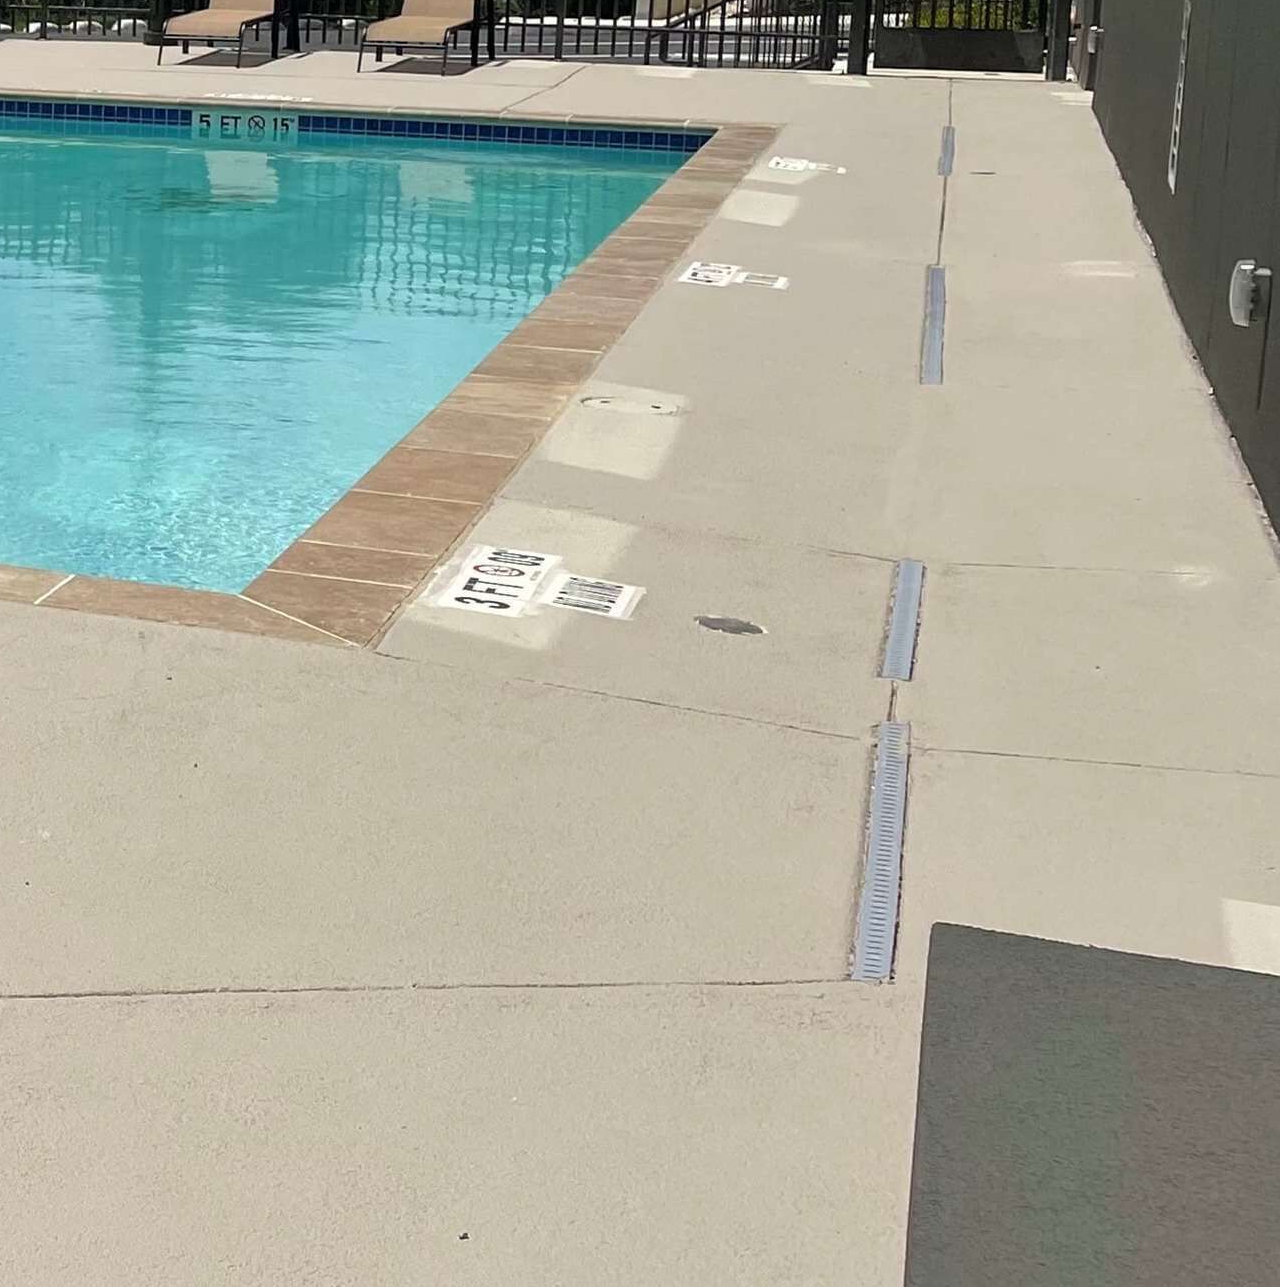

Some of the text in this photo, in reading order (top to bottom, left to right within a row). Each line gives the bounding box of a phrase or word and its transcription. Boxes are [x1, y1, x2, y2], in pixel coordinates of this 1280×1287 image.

[199, 114, 211, 130] 5
[462, 577, 524, 598] FT
[454, 596, 511, 609] 3
